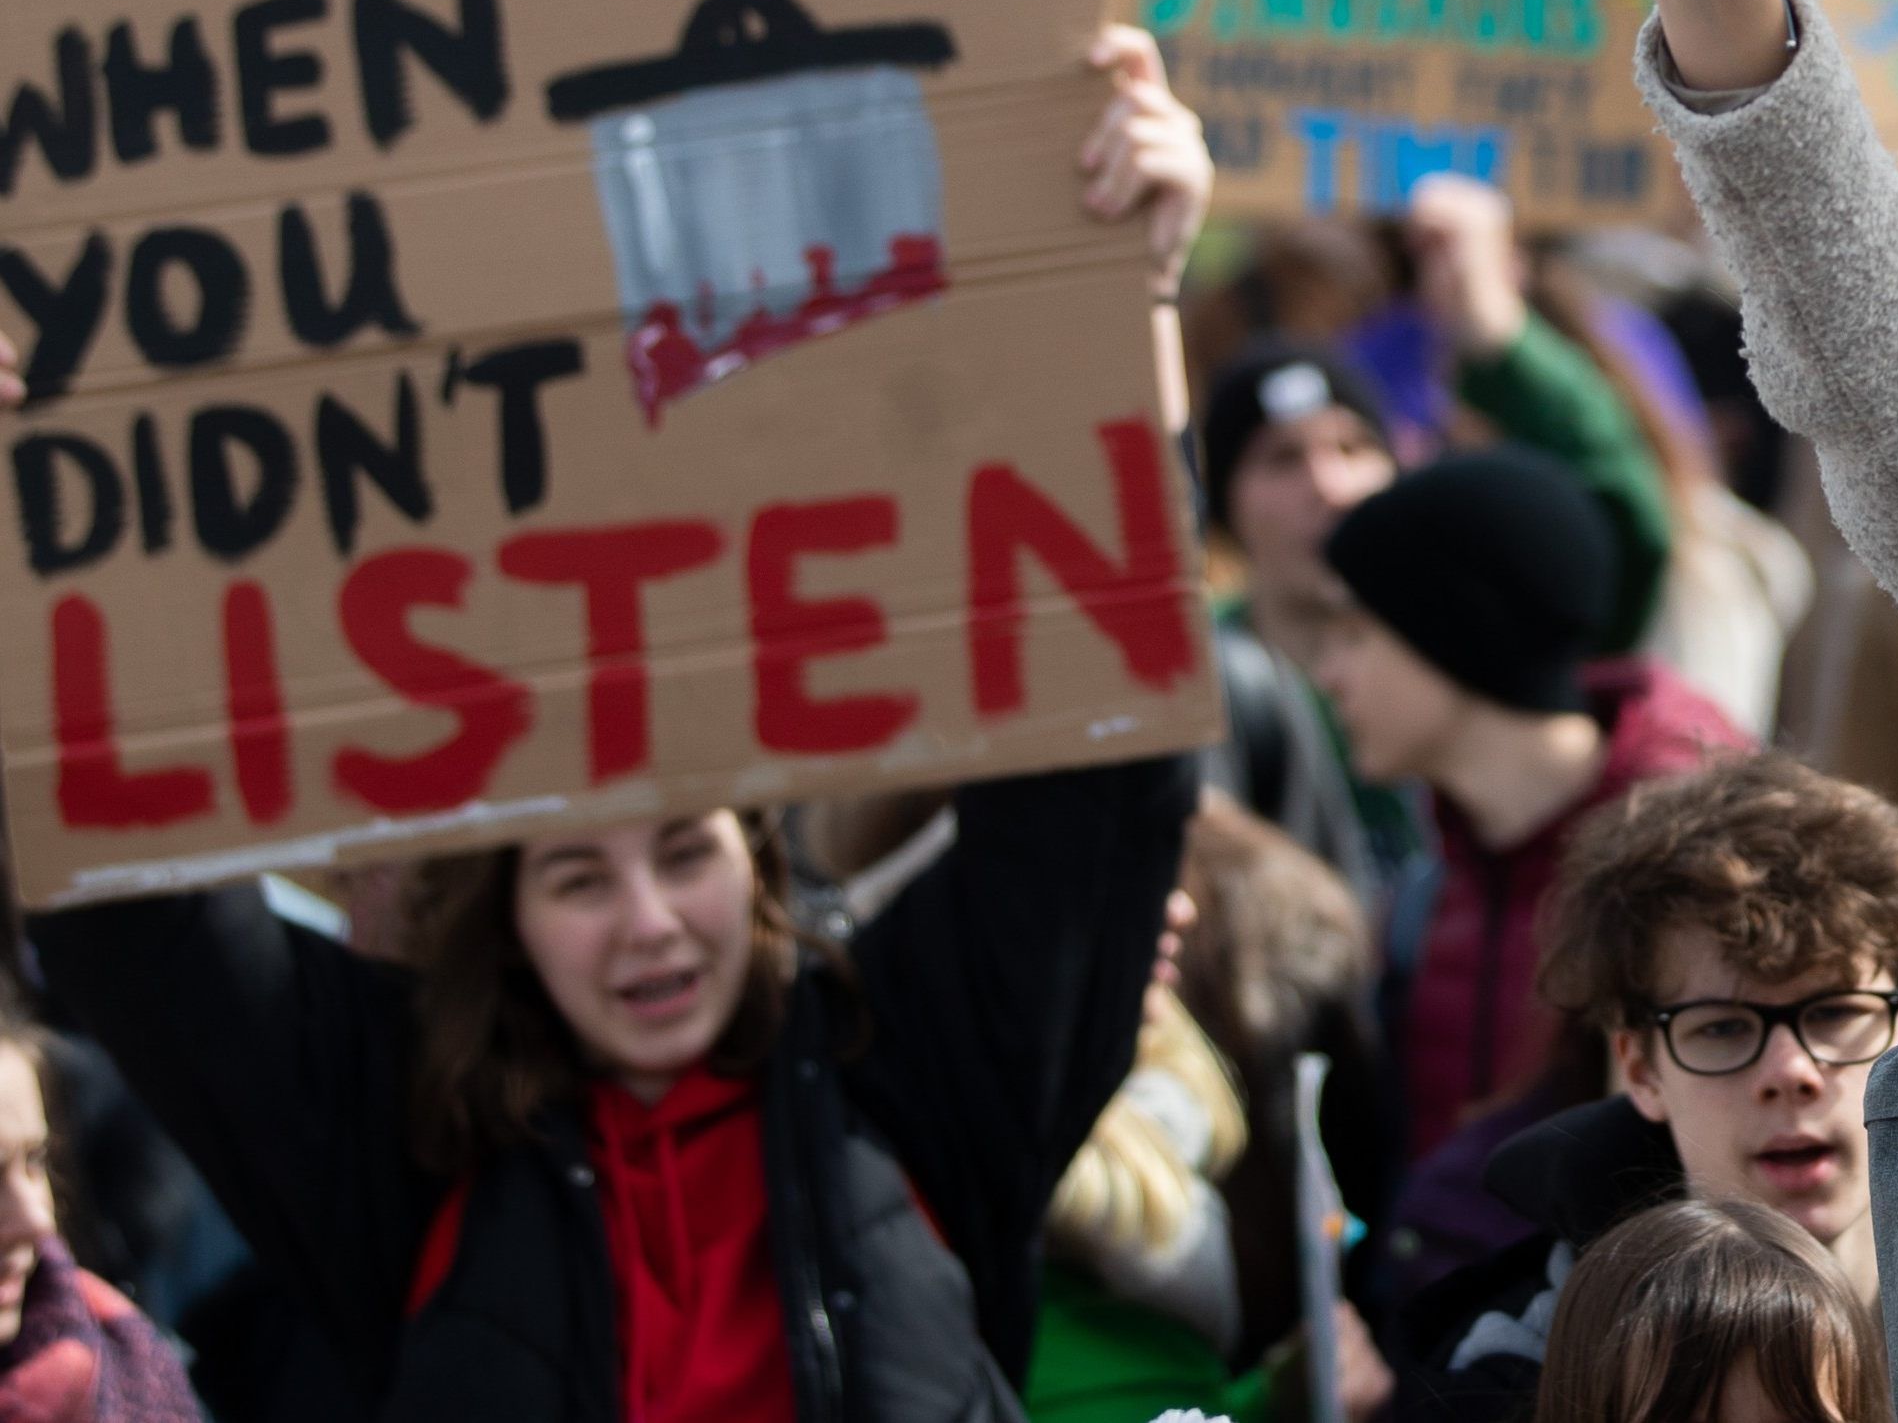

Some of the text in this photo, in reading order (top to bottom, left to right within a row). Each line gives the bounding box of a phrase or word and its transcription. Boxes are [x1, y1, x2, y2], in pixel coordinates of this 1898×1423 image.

[0, 188, 424, 409] YOU
[8, 337, 587, 580] DIDN'T
[51, 416, 1197, 832] LISTEN
